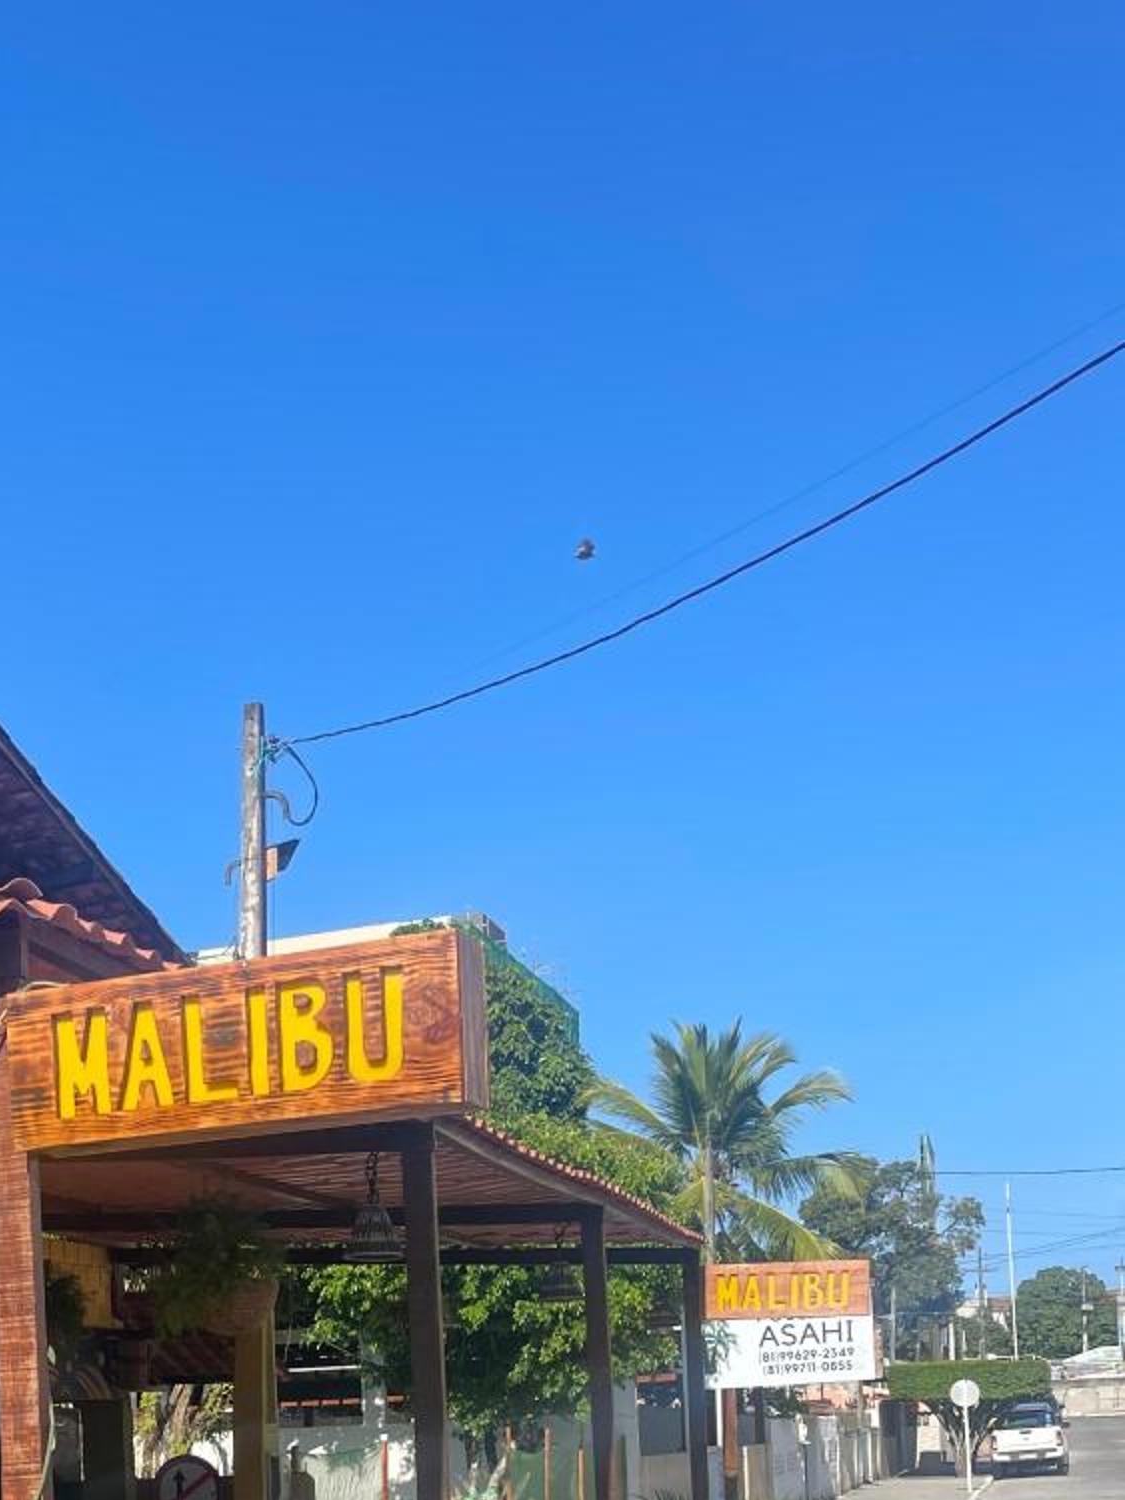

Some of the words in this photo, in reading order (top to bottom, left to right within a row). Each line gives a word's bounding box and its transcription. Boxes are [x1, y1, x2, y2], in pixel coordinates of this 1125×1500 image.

[54, 966, 405, 1120] MALIBU
[716, 1270, 852, 1314] MALIBU
[758, 1319, 854, 1348] ASAHI
